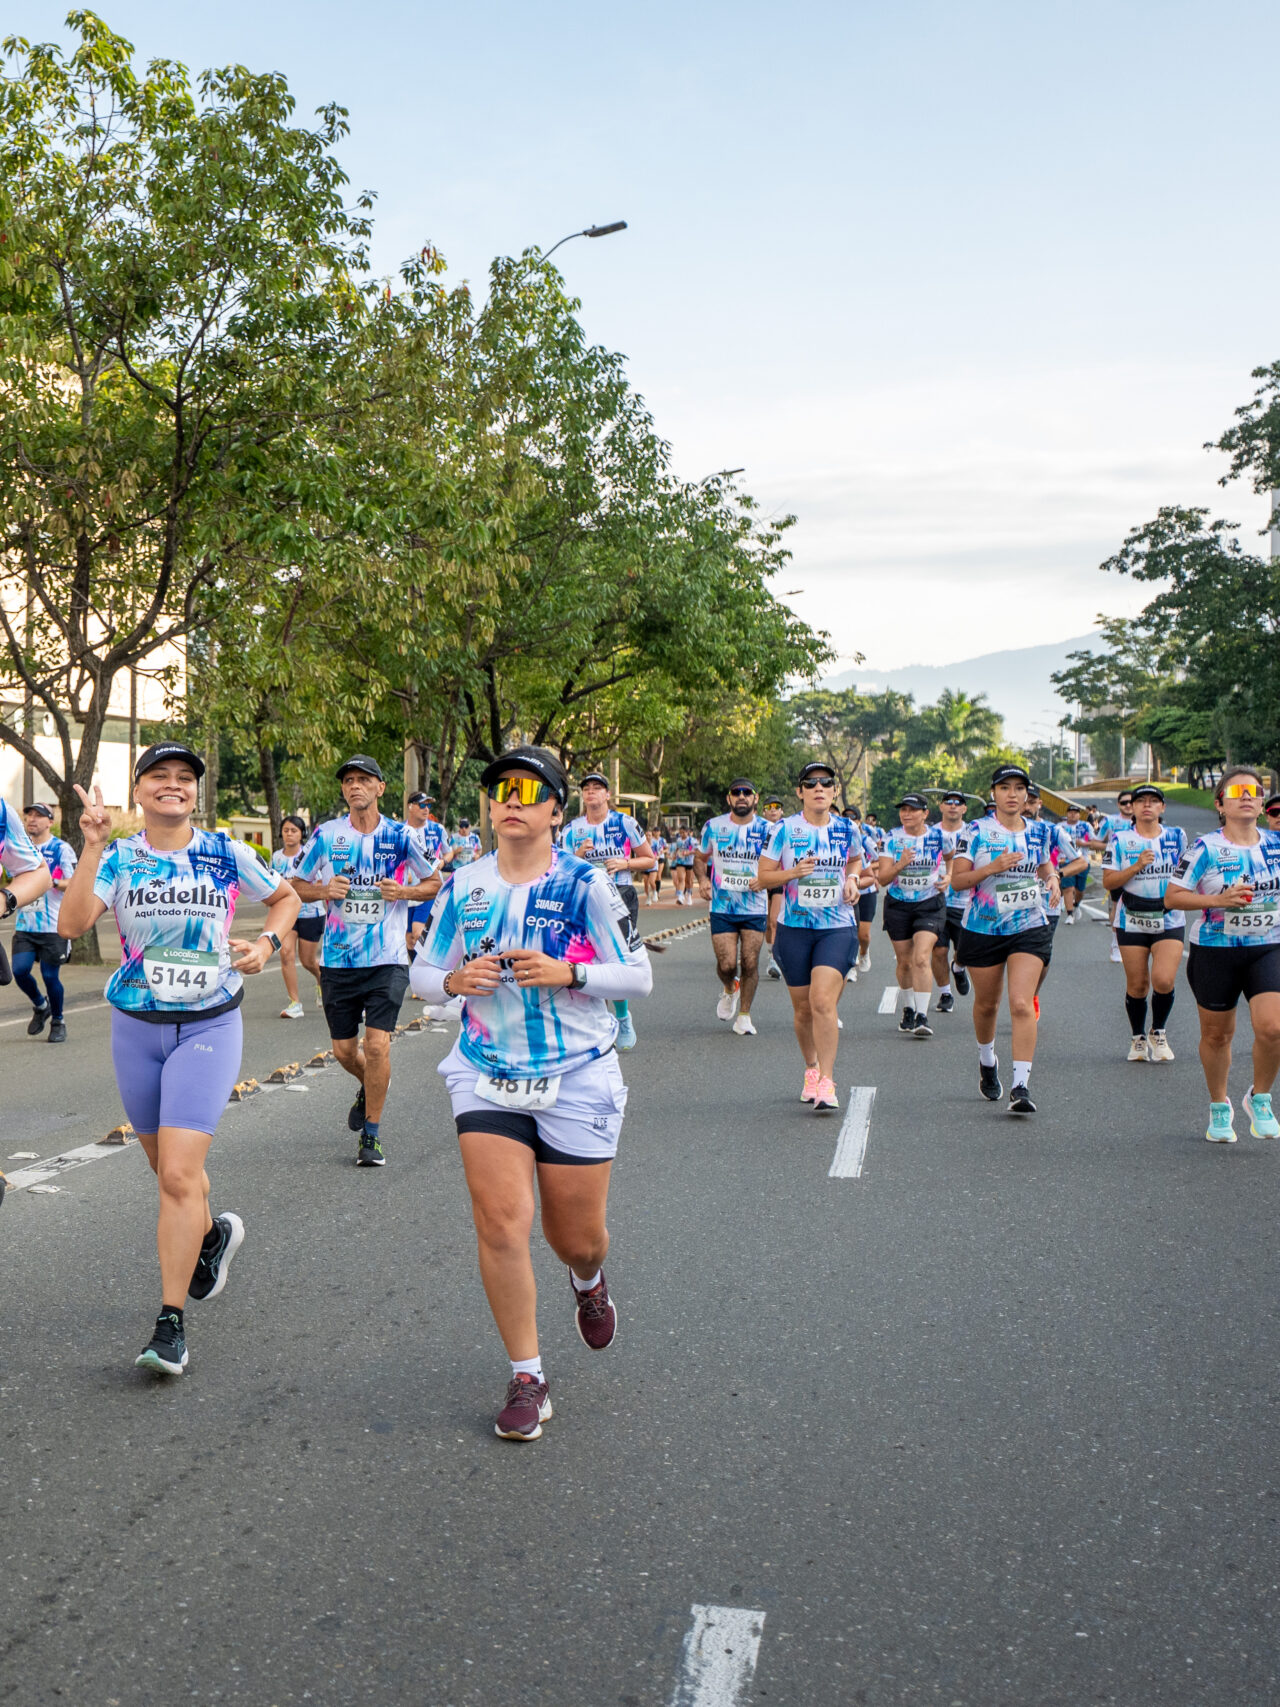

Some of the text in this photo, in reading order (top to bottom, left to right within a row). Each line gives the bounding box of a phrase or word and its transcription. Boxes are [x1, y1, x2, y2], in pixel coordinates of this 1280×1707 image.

[374, 852, 397, 862] epm
[724, 876, 749, 886] 4800
[901, 878, 928, 886] 4842
[124, 884, 229, 909] Medellín
[803, 889, 835, 898] 4871
[1002, 889, 1037, 903] 4789
[345, 901, 380, 914] 5142
[534, 898, 564, 913] SUAREZ
[135, 908, 216, 919] Aquí todo florece
[526, 915, 565, 934] epm
[1129, 917, 1161, 929] 4483
[1229, 915, 1274, 927] 4552
[151, 966, 208, 989] 5144
[194, 1043, 213, 1052] FILA
[489, 1077, 549, 1095] 4814
